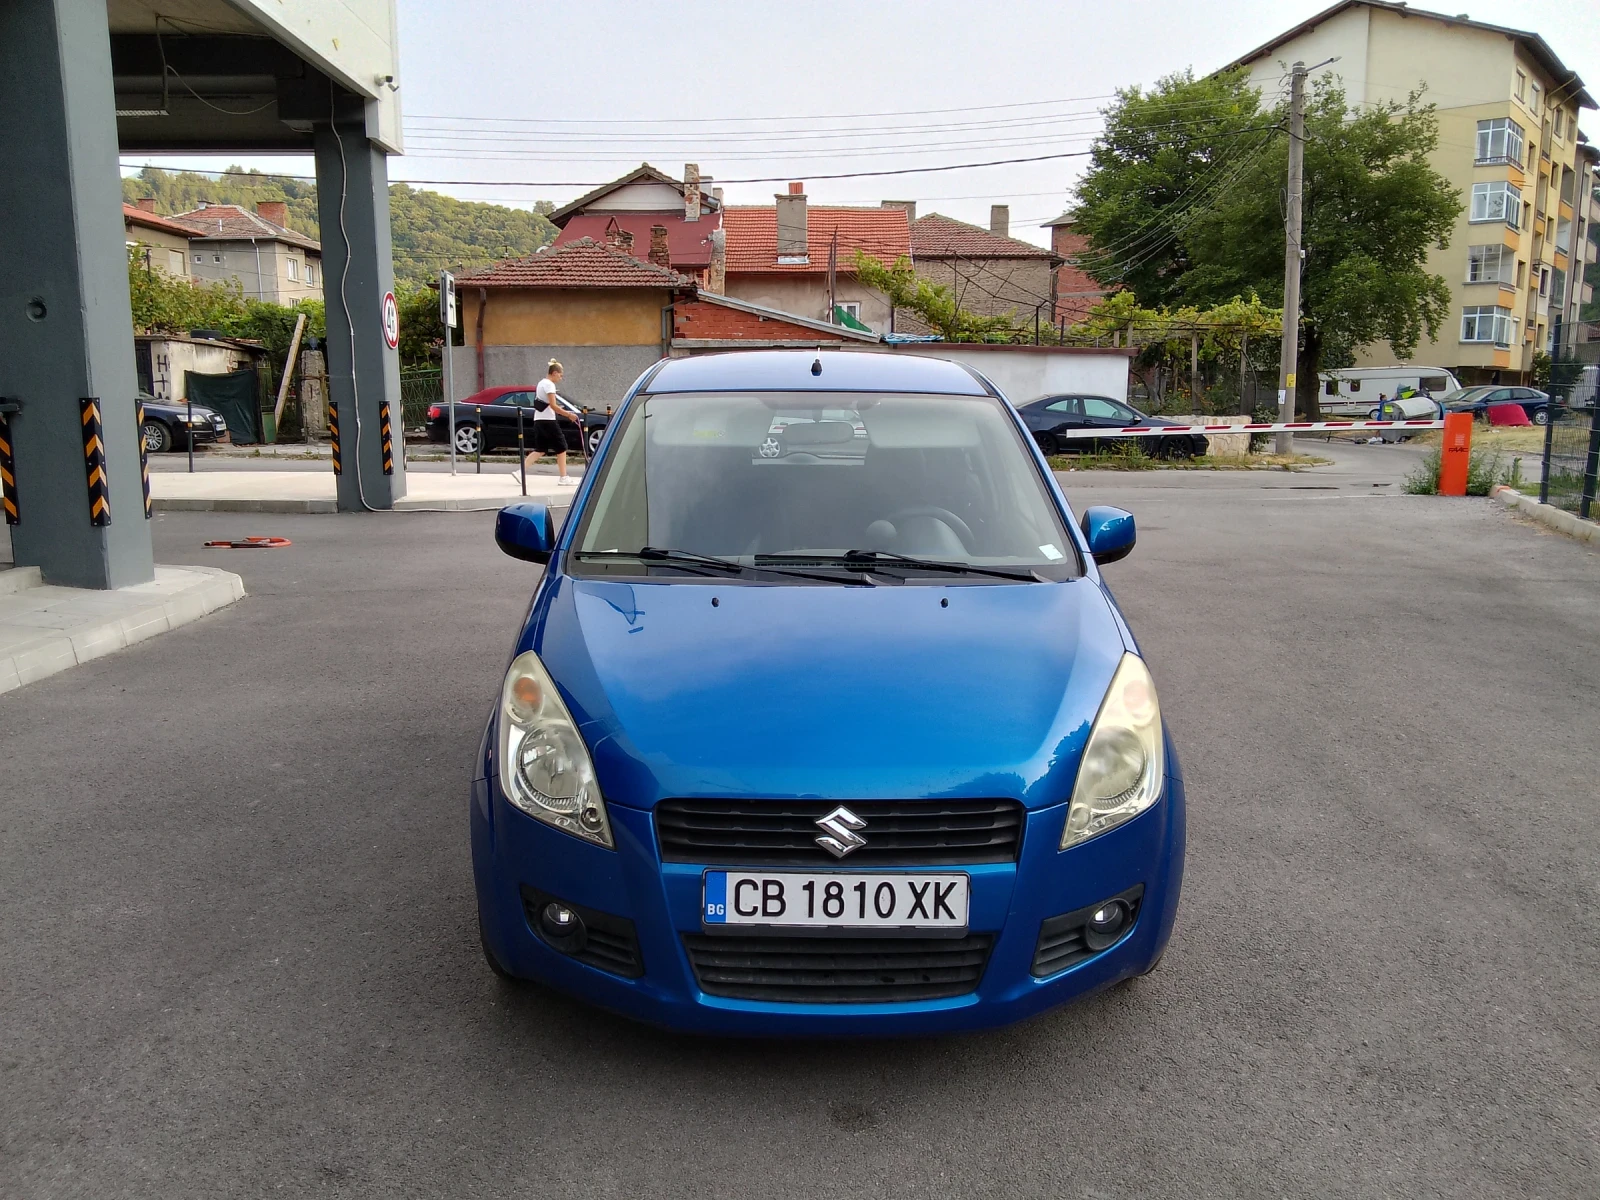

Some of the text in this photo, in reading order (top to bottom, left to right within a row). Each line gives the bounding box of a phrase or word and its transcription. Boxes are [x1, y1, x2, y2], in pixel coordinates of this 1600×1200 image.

[707, 903, 725, 916] BG
[733, 878, 958, 920] CB 1810 XK
